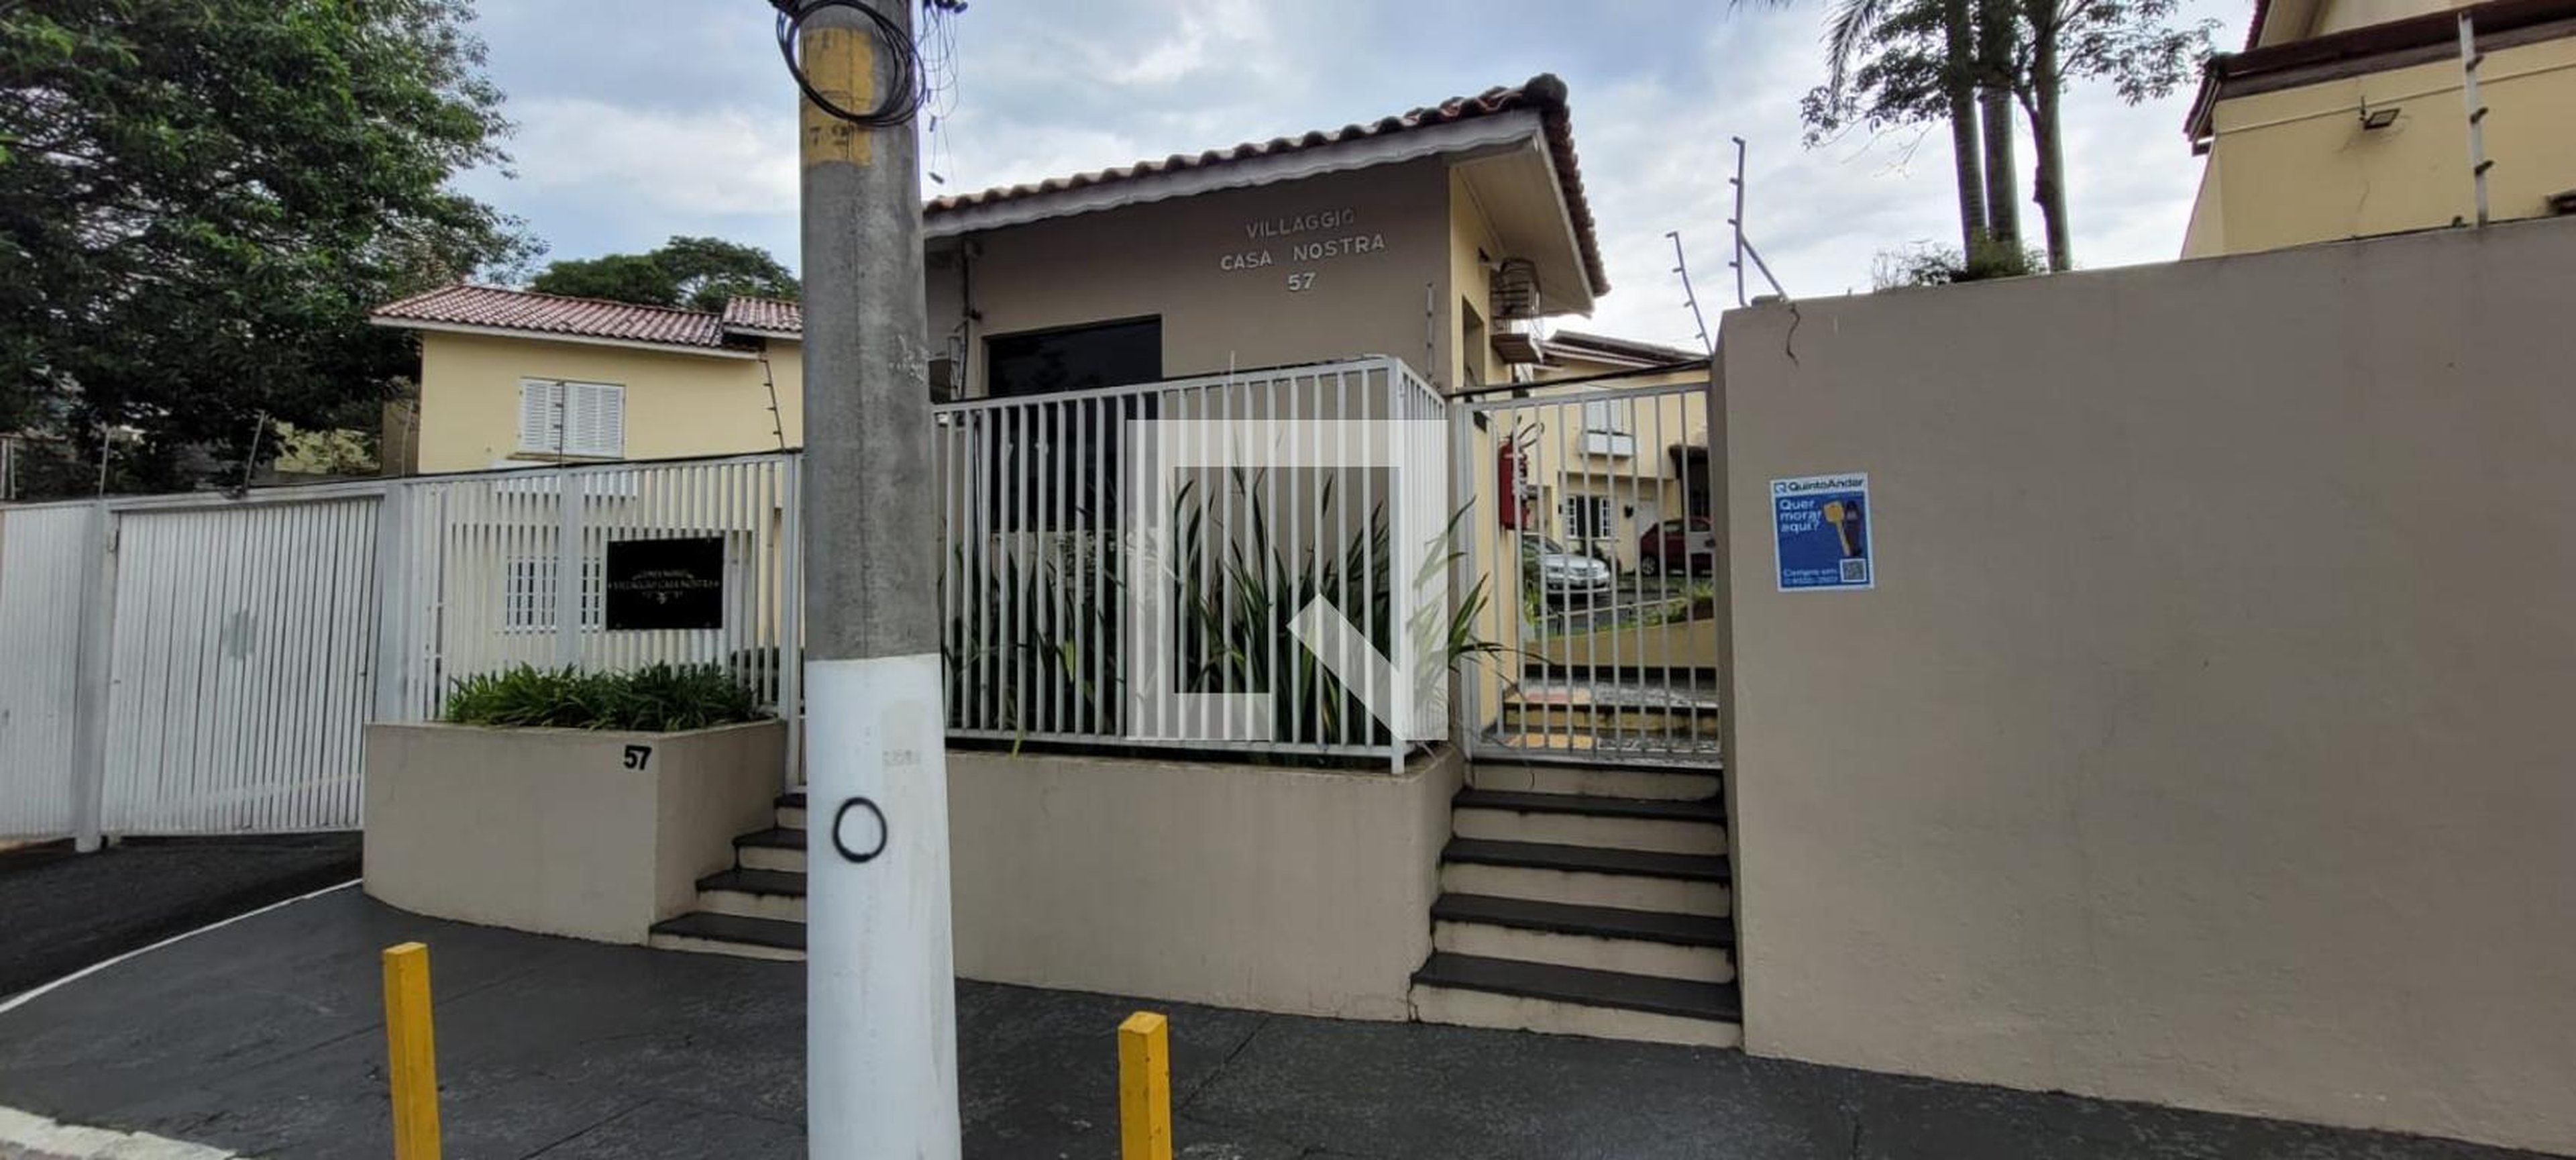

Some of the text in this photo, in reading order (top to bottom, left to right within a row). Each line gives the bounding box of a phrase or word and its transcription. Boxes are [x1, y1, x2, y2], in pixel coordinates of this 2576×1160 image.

[1246, 209, 1354, 238] VILLAGGIO
[1220, 233, 1386, 270] CASA NOSTRA
[1288, 272, 1316, 291] 57
[1788, 478, 1864, 492] QuintoAndar
[1780, 499, 1815, 510] Quer
[1780, 510, 1822, 521] morar
[1780, 519, 1820, 535] aqui?
[624, 744, 652, 771] 57
